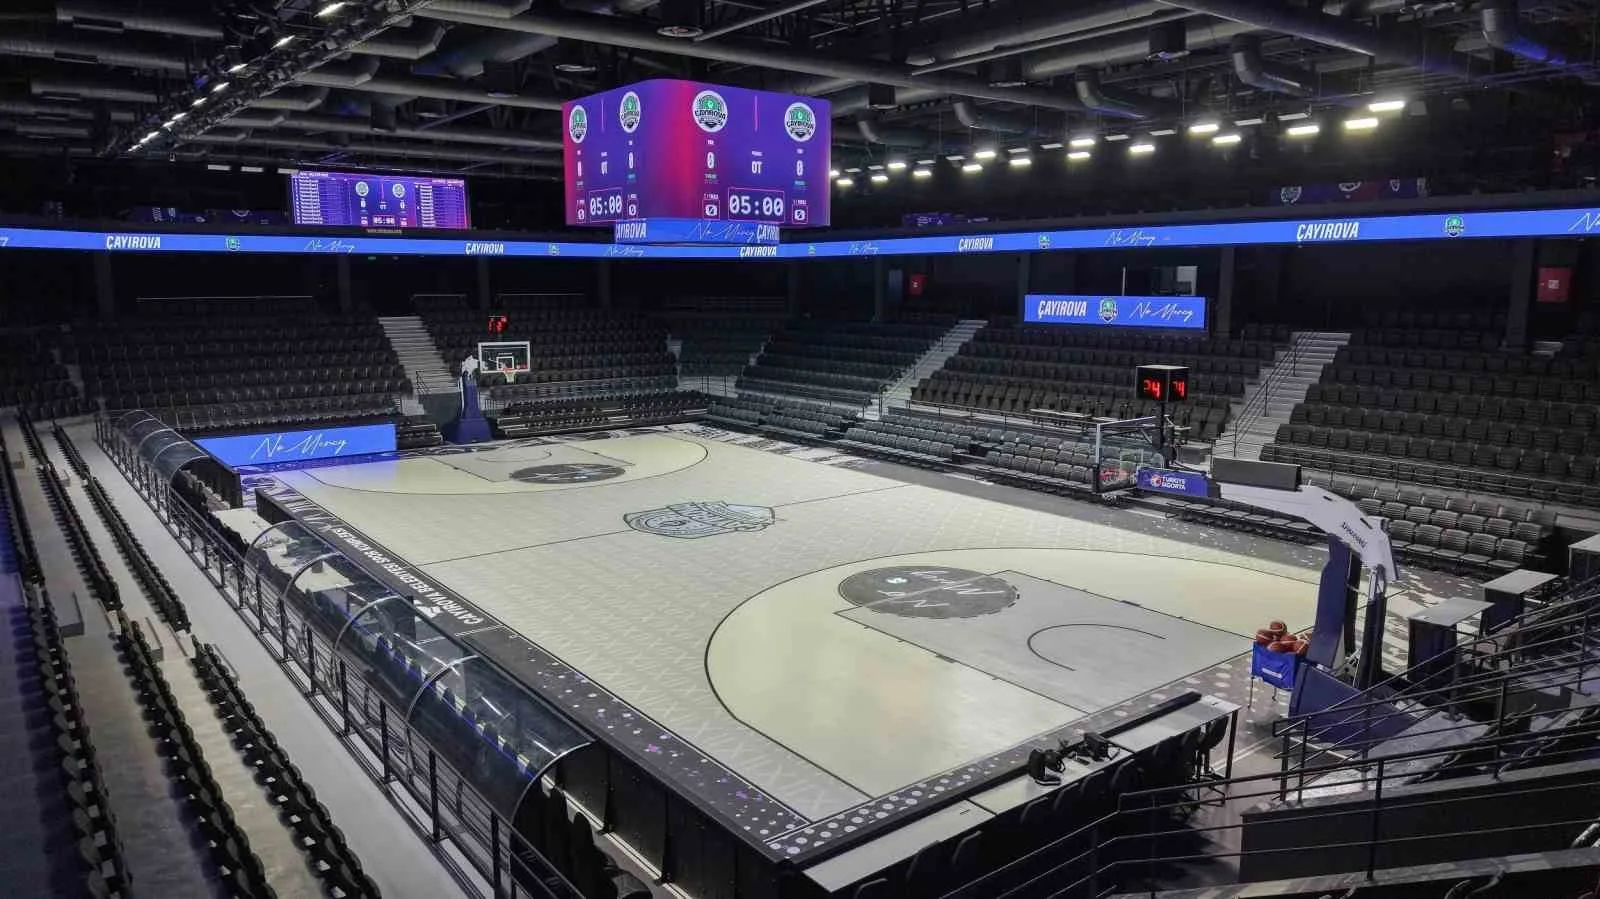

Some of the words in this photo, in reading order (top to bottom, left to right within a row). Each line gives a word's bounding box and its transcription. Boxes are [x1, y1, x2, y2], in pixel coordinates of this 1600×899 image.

[589, 194, 623, 216] 05:00
[729, 194, 784, 216] 05:00
[1296, 222, 1360, 242] ÇAYIROVA
[106, 235, 161, 251] ÇAYIROVA
[740, 246, 777, 259] ÇAYIROVA
[958, 237, 993, 253] ÇAYIROVA
[1038, 300, 1087, 319] ÇAYIROVA
[250, 435, 284, 459] No
[284, 433, 347, 456] Mercy
